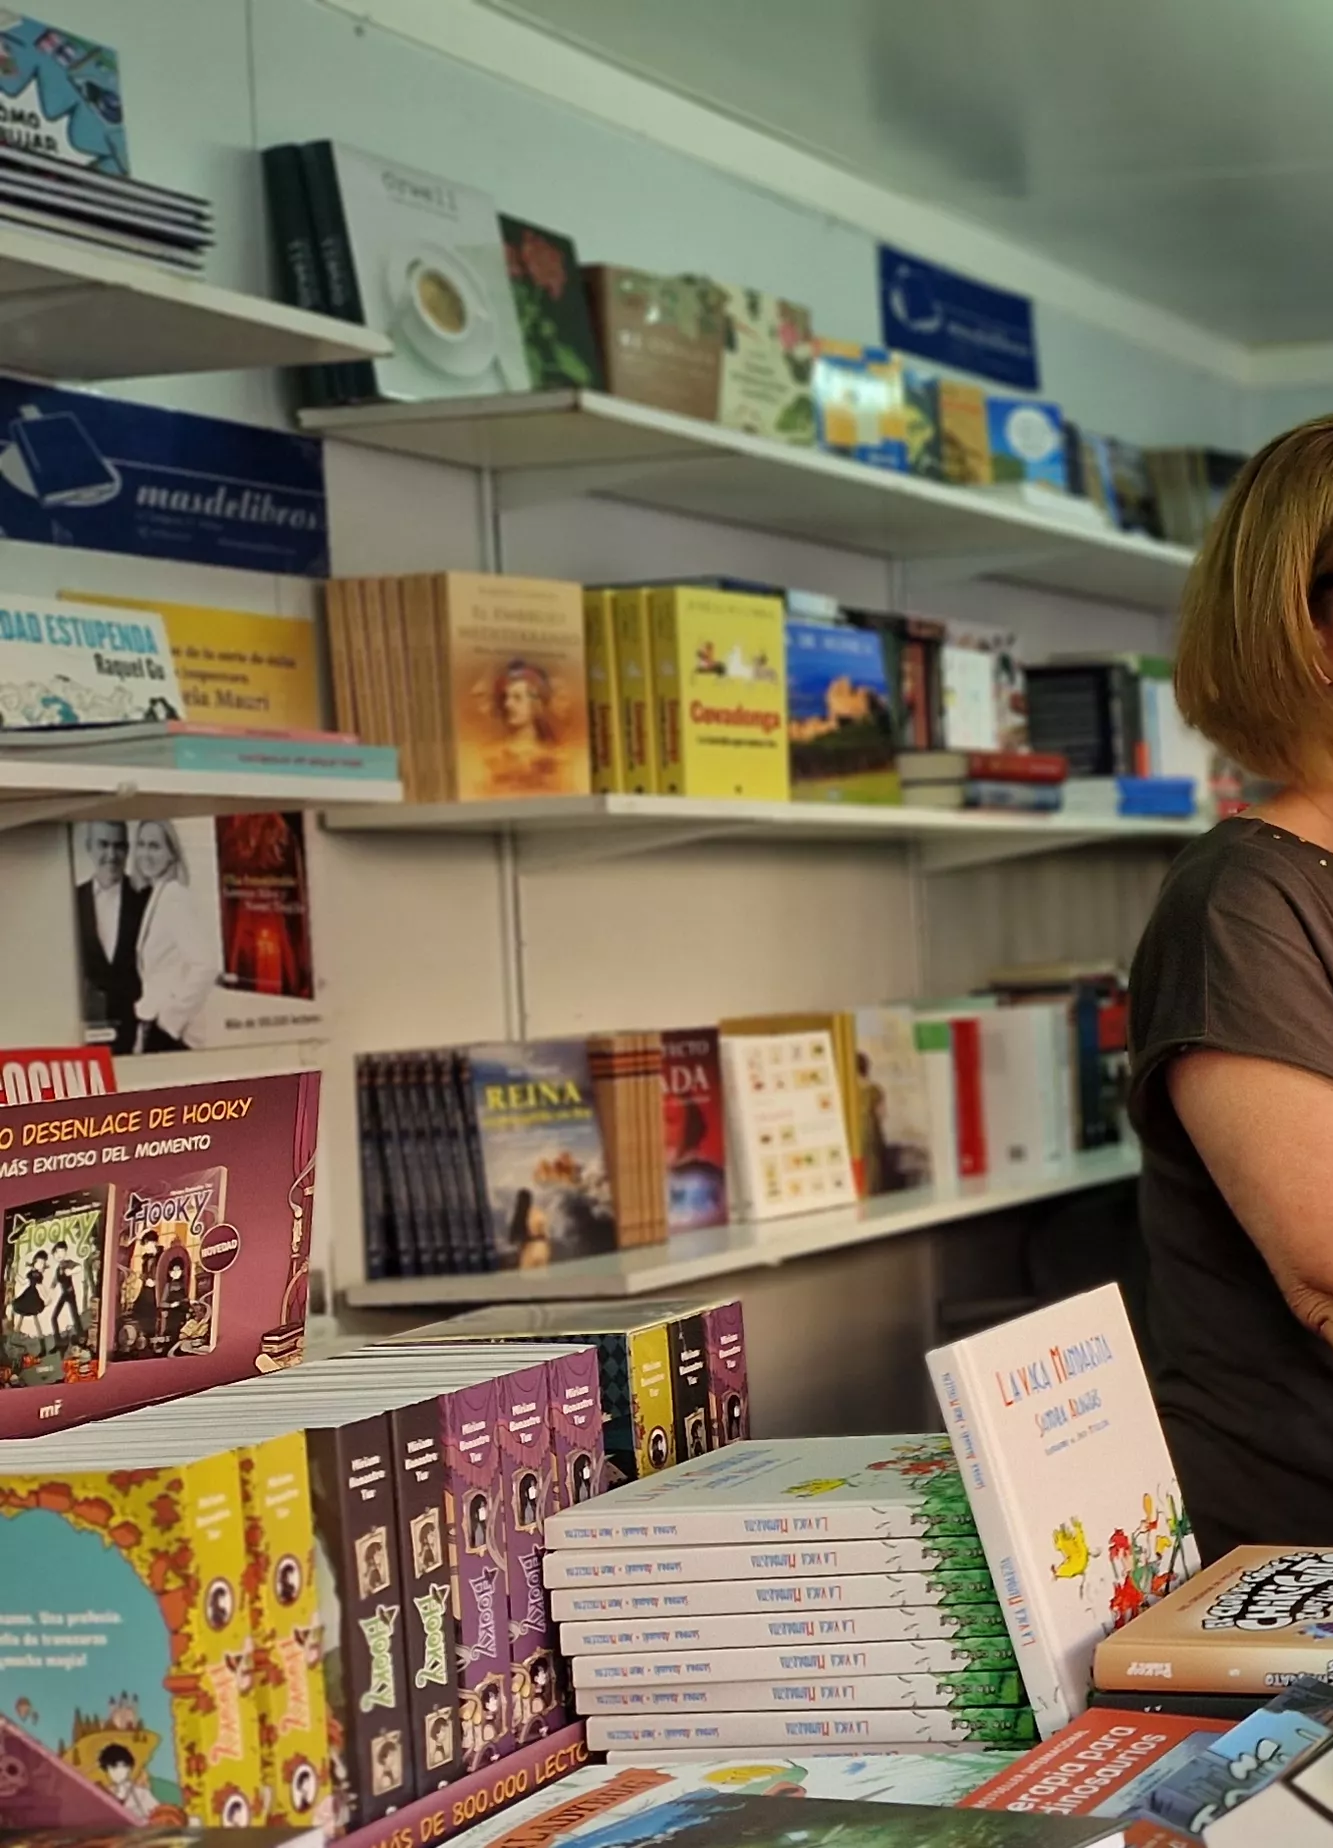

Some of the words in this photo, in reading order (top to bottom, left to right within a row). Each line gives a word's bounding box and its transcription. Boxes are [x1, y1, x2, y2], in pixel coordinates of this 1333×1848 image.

[137, 484, 317, 531] masdelibros
[0, 609, 40, 644] DAD
[47, 614, 160, 656] ESTUPENDA
[94, 653, 145, 682] Raquel
[0, 1060, 106, 1105] OCINA
[485, 1080, 582, 1111] REINA
[22, 1111, 142, 1146] DESENLACE
[149, 1106, 176, 1129] DE
[182, 1097, 253, 1122] HOOKY
[33, 1147, 97, 1175] EXITOSO
[101, 1143, 130, 1164] DEL
[134, 1135, 211, 1159] MOMENTO
[201, 1239, 238, 1258] NOVEDAD
[996, 1371, 1021, 1407] LA
[1017, 1360, 1053, 1397] VACA
[1049, 1334, 1113, 1385] MANDARINA
[359, 1604, 399, 1712] HOOKY
[414, 1583, 450, 1690] HOOKY
[1082, 1725, 1138, 1761] para
[418, 1814, 446, 1841] DE
[450, 1774, 528, 1829] 800.000
